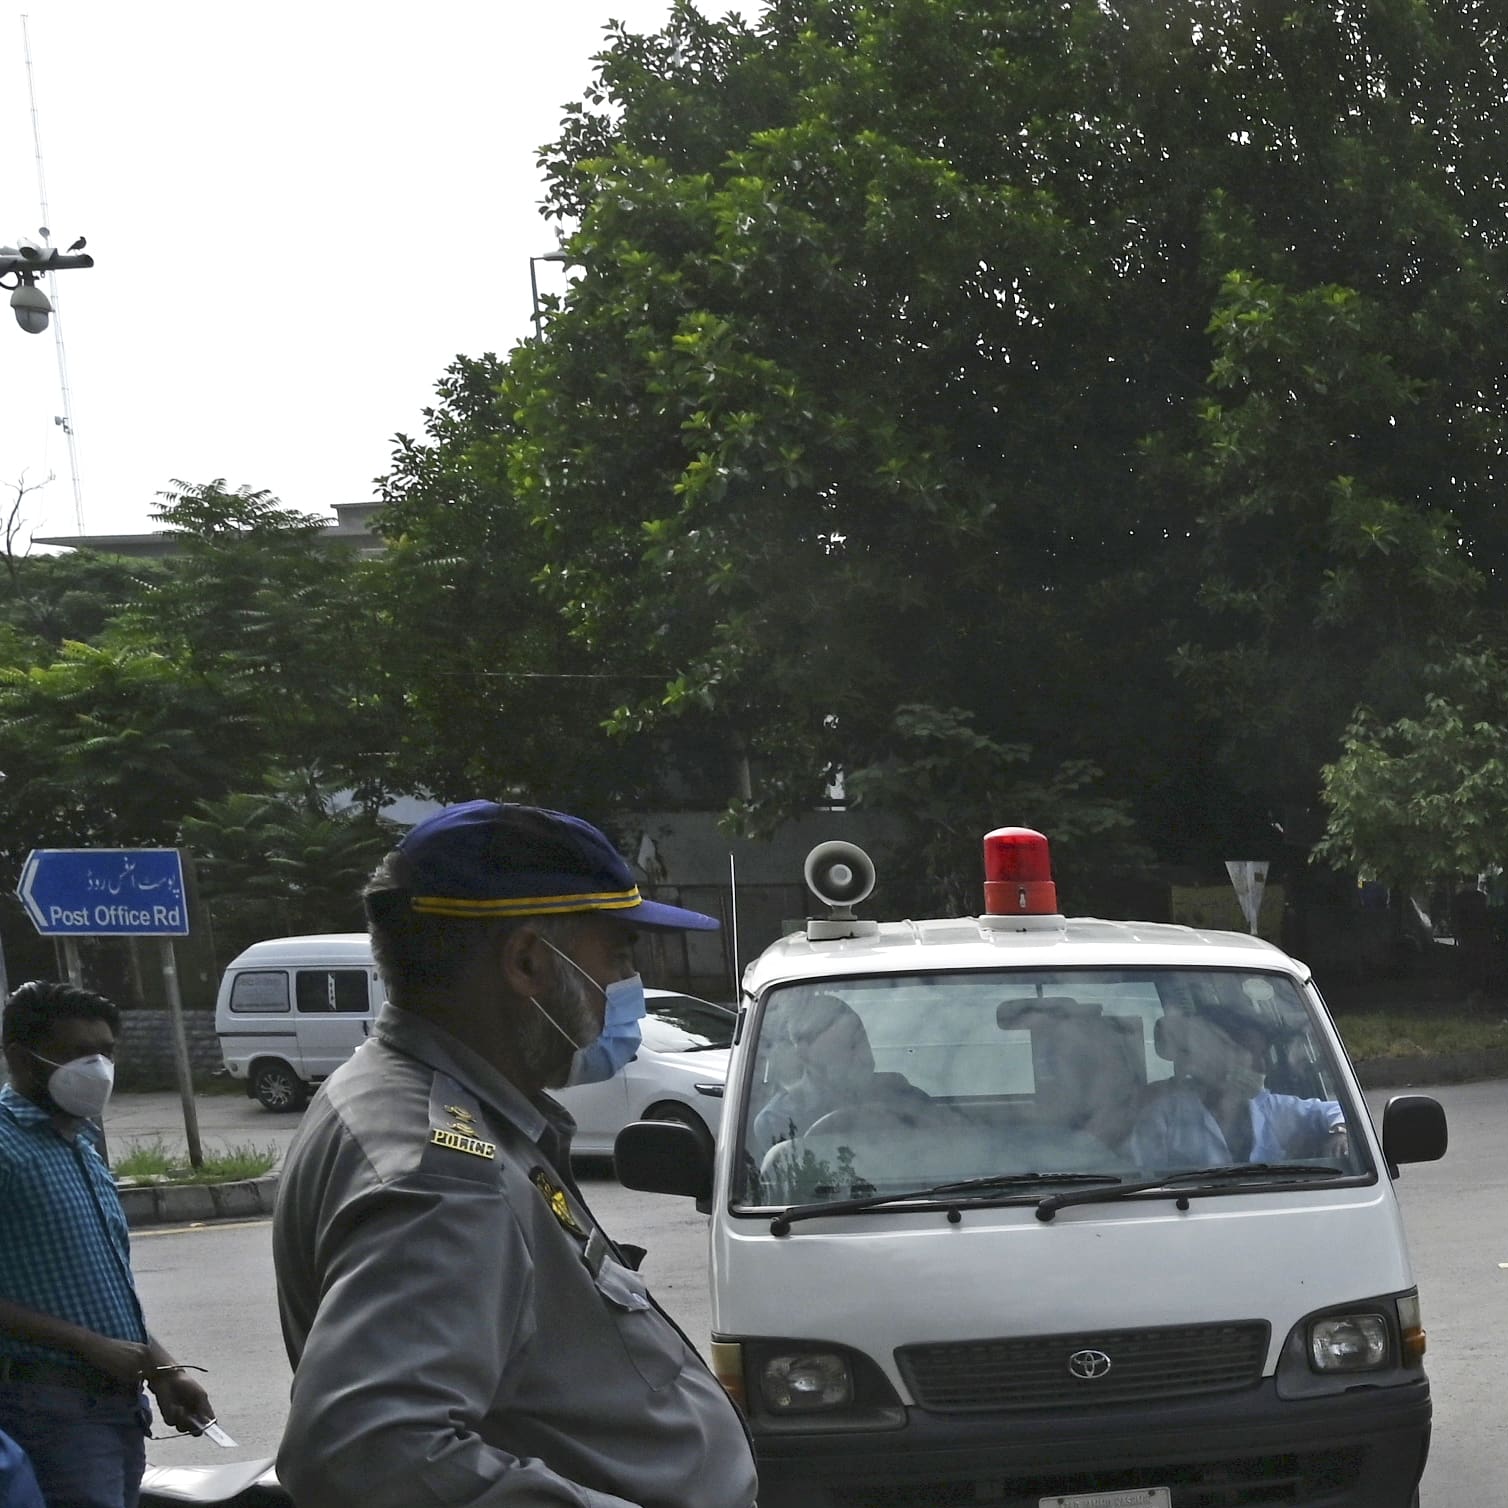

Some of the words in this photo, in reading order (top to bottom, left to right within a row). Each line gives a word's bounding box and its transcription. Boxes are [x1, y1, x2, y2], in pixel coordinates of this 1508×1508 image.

[50, 905, 90, 926] Post
[94, 905, 151, 926] Office
[153, 905, 181, 926] Rd
[430, 1128, 497, 1160] POLICE
